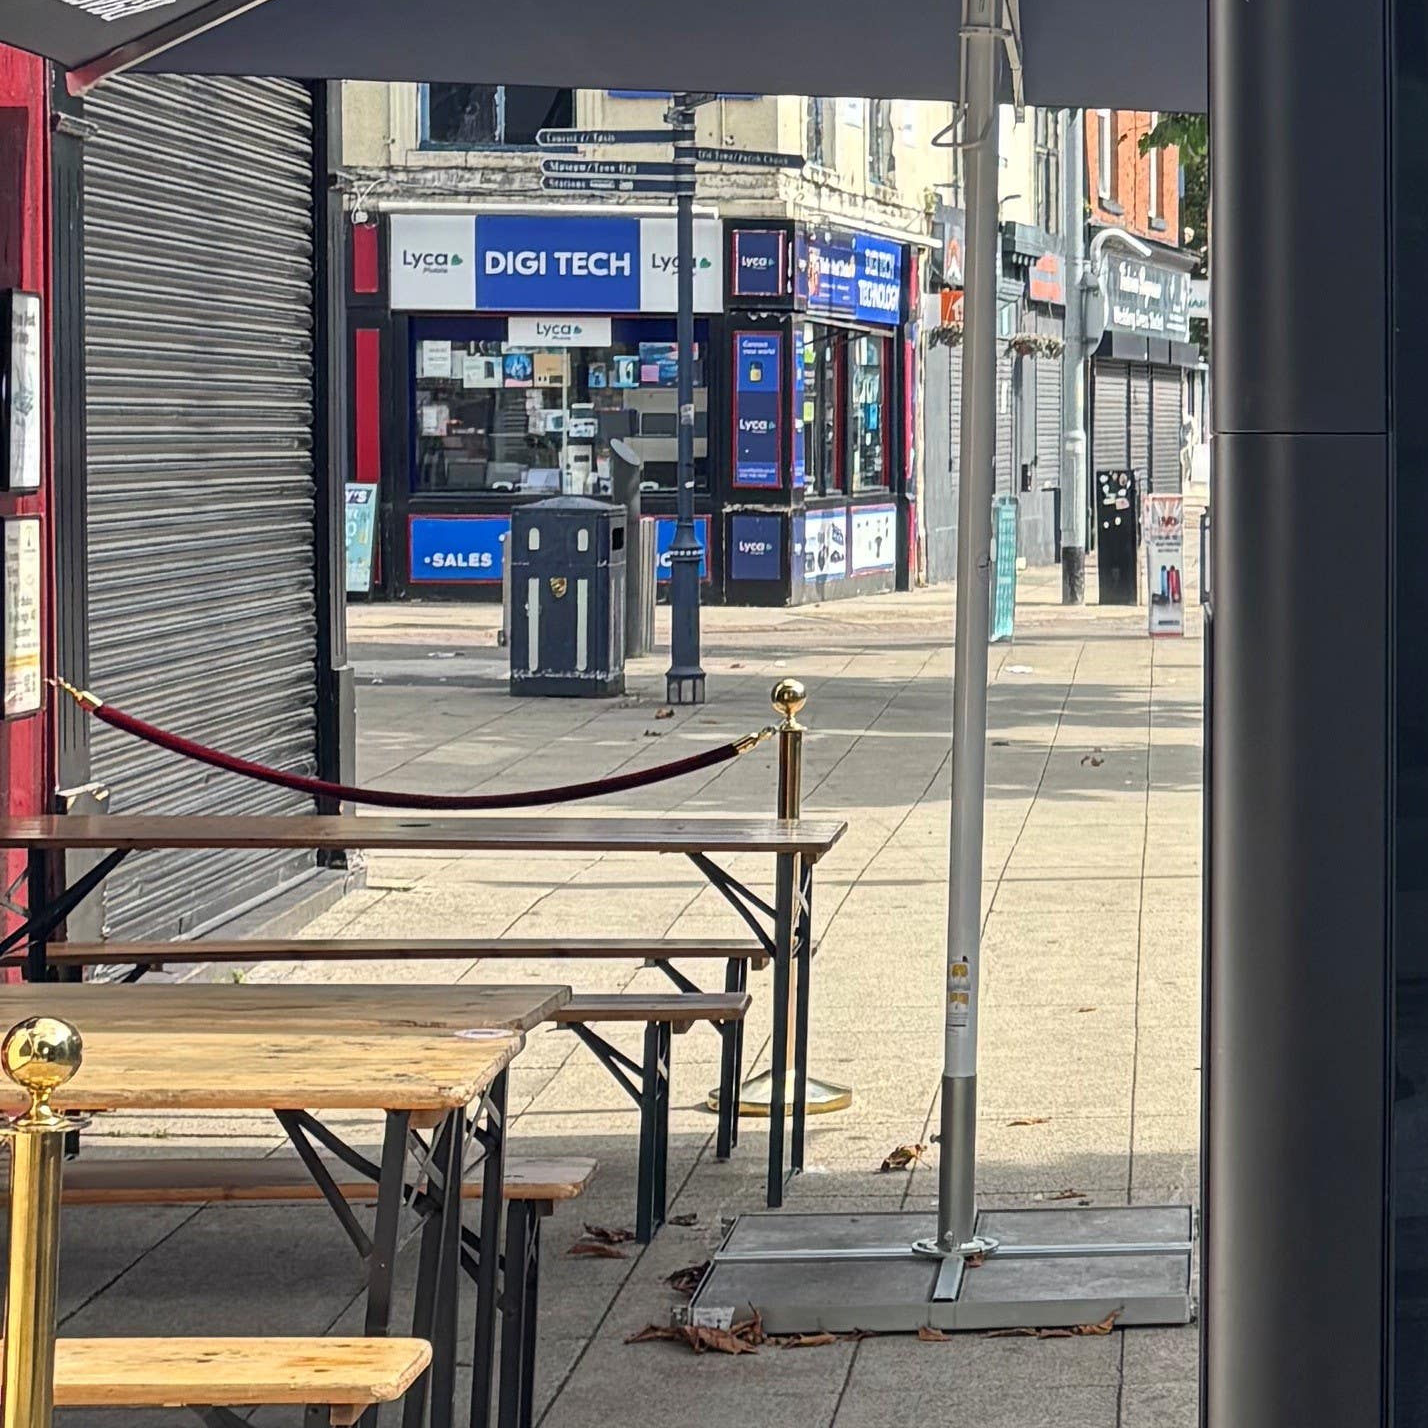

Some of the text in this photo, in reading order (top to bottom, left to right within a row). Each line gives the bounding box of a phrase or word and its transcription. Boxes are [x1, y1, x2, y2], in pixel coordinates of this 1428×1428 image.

[403, 249, 448, 268] Lyca
[485, 250, 631, 277] DIGI TECH
[742, 256, 767, 268] Lyca
[857, 279, 900, 312] TECHNOLOGY
[536, 323, 571, 337] Lyca
[739, 420, 767, 431] Lyca
[739, 541, 765, 553] Lyca
[432, 552, 492, 568] SALES
